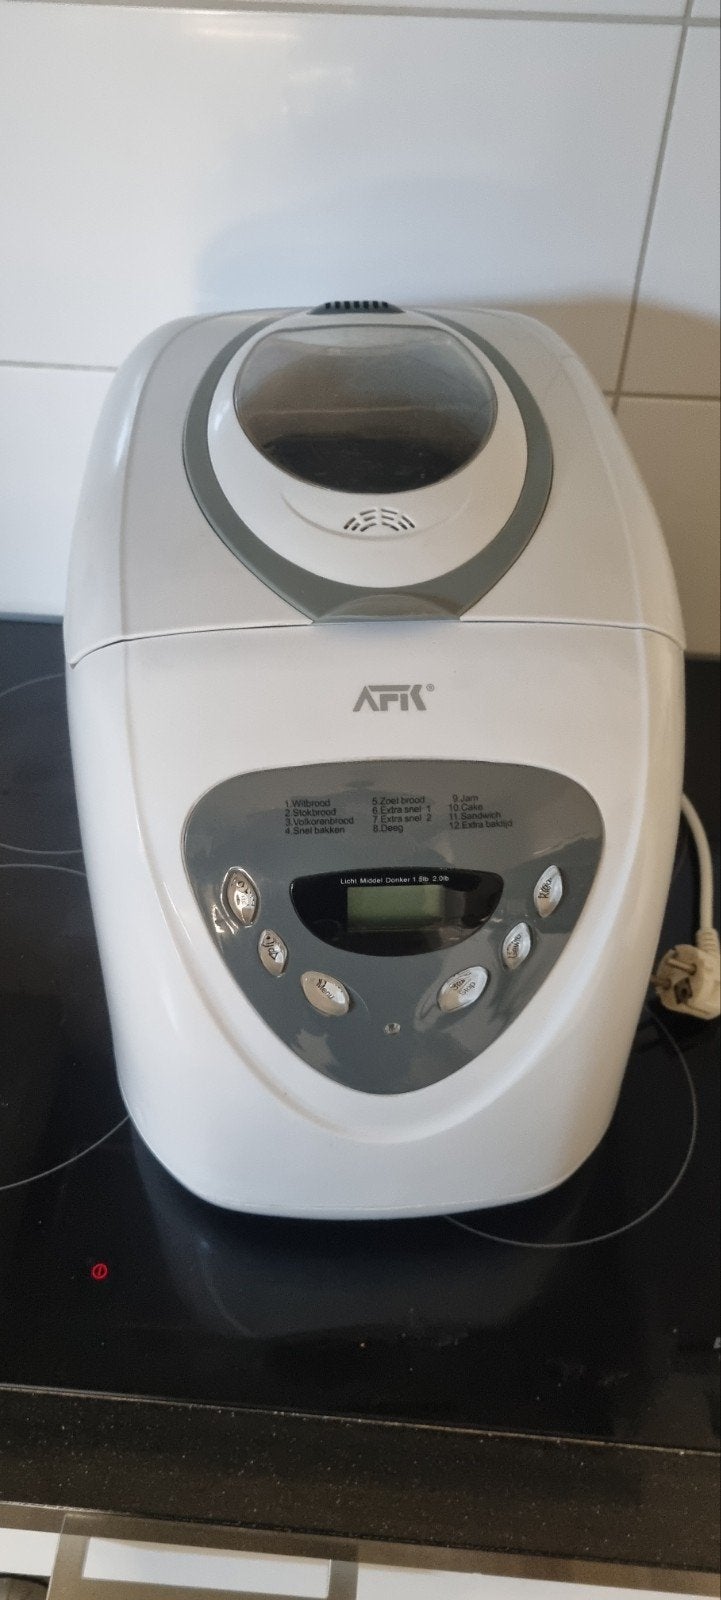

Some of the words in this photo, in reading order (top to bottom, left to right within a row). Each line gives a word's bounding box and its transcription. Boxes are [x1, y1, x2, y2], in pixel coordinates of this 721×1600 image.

[400, 795, 425, 804] brood
[404, 805, 422, 814] snel
[404, 814, 422, 823] snel
[426, 813, 432, 822] 2
[314, 826, 345, 834] bakken
[340, 877, 358, 885] Licht
[385, 876, 410, 884] Donker
[315, 979, 335, 999] Menu
